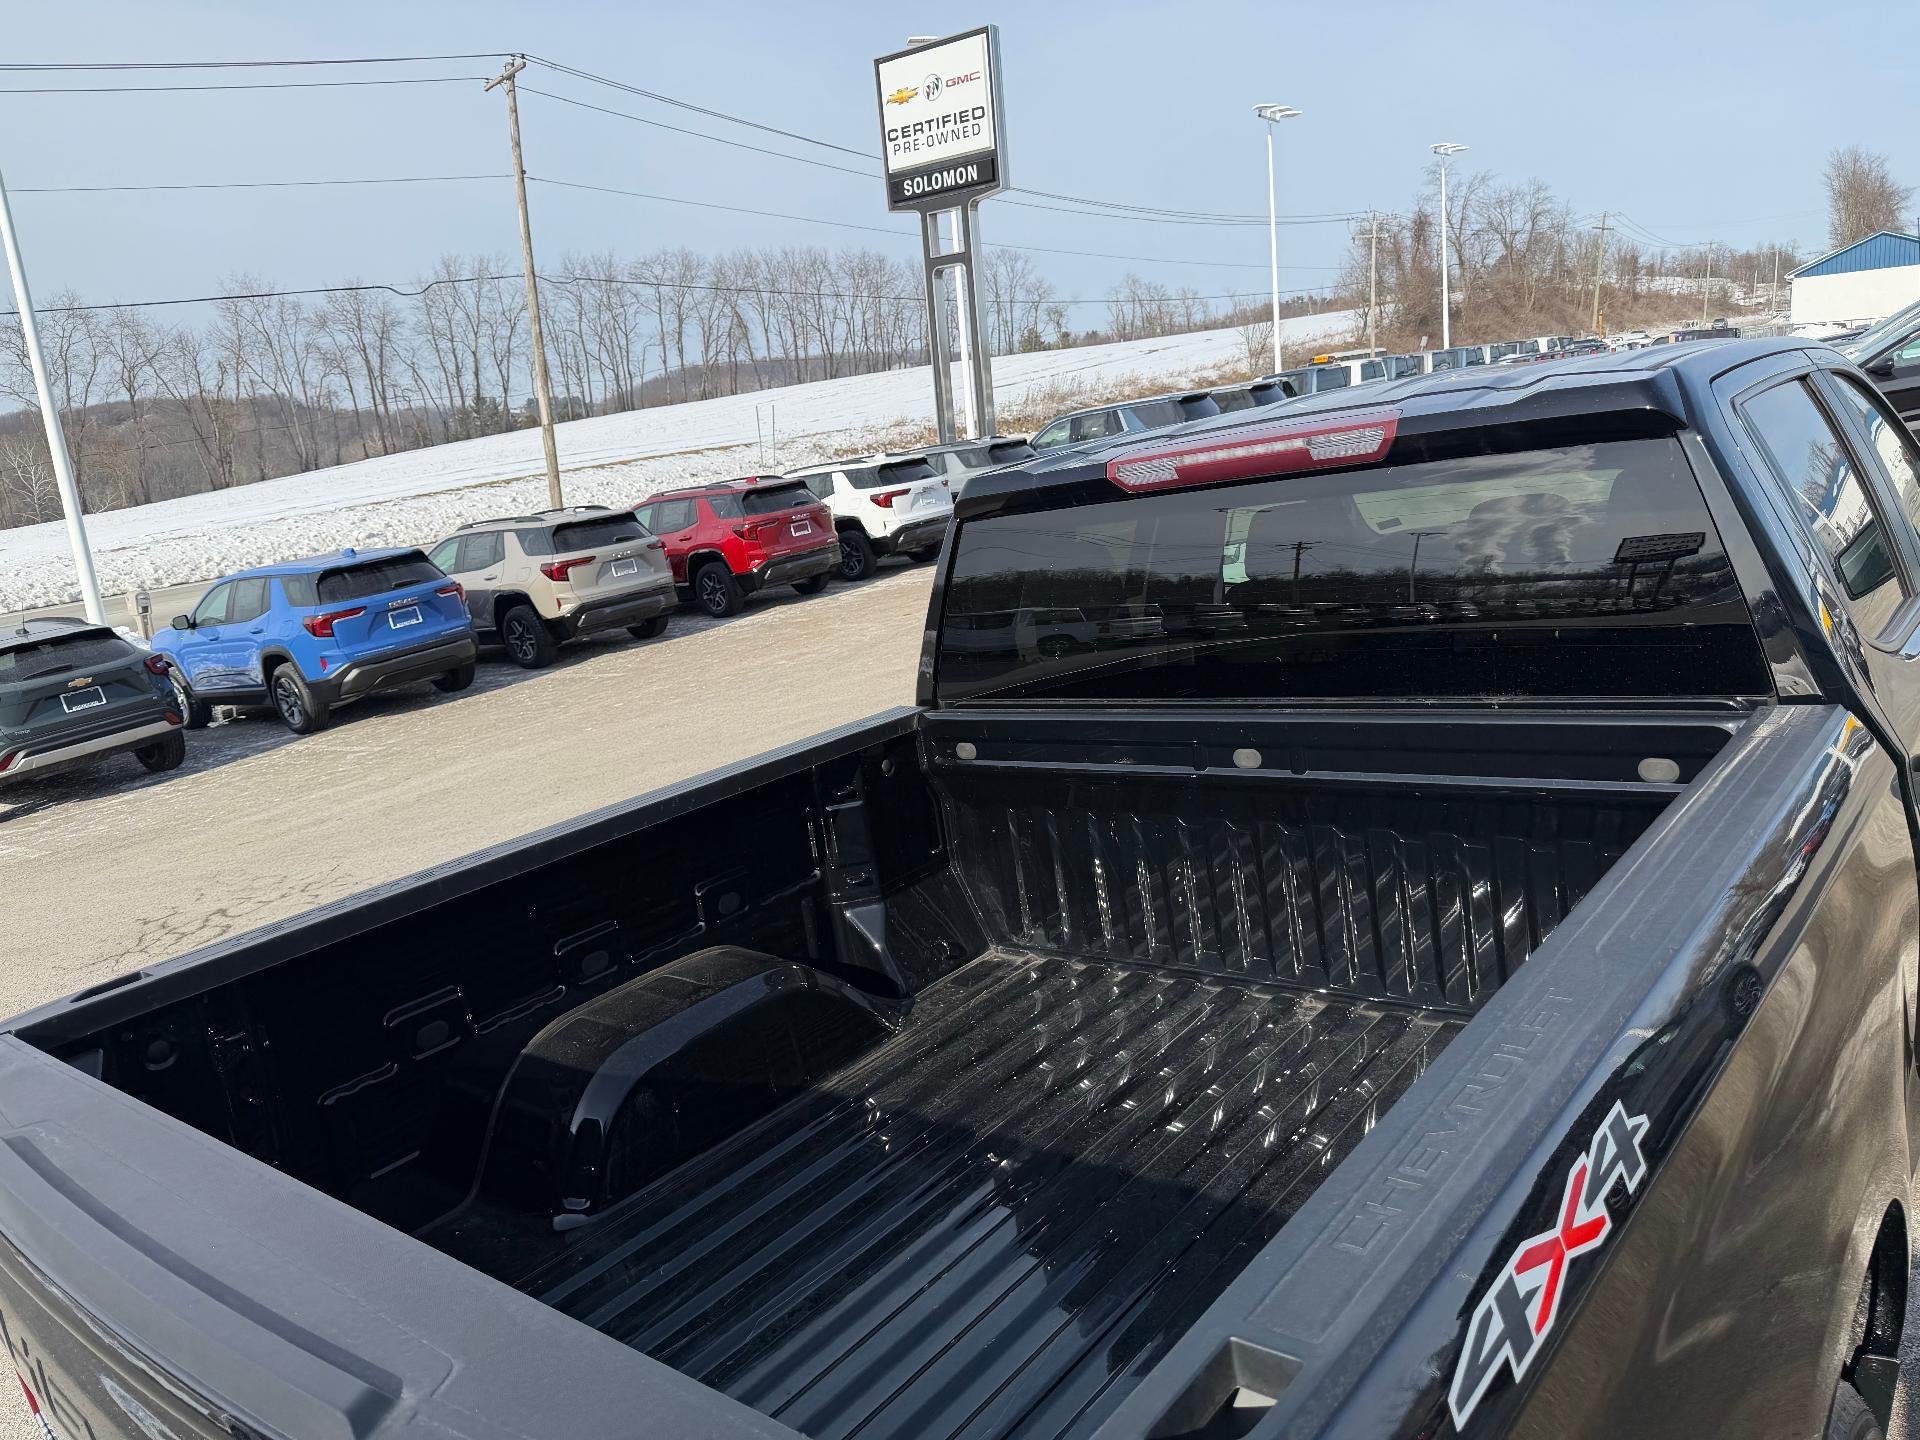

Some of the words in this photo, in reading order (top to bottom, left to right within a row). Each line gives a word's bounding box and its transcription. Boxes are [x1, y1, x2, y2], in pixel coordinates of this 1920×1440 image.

[945, 71, 981, 88] GMC
[887, 105, 986, 143] CERTIFIED
[893, 123, 981, 156] PRE-OWNED
[903, 164, 978, 196] SOLOMON
